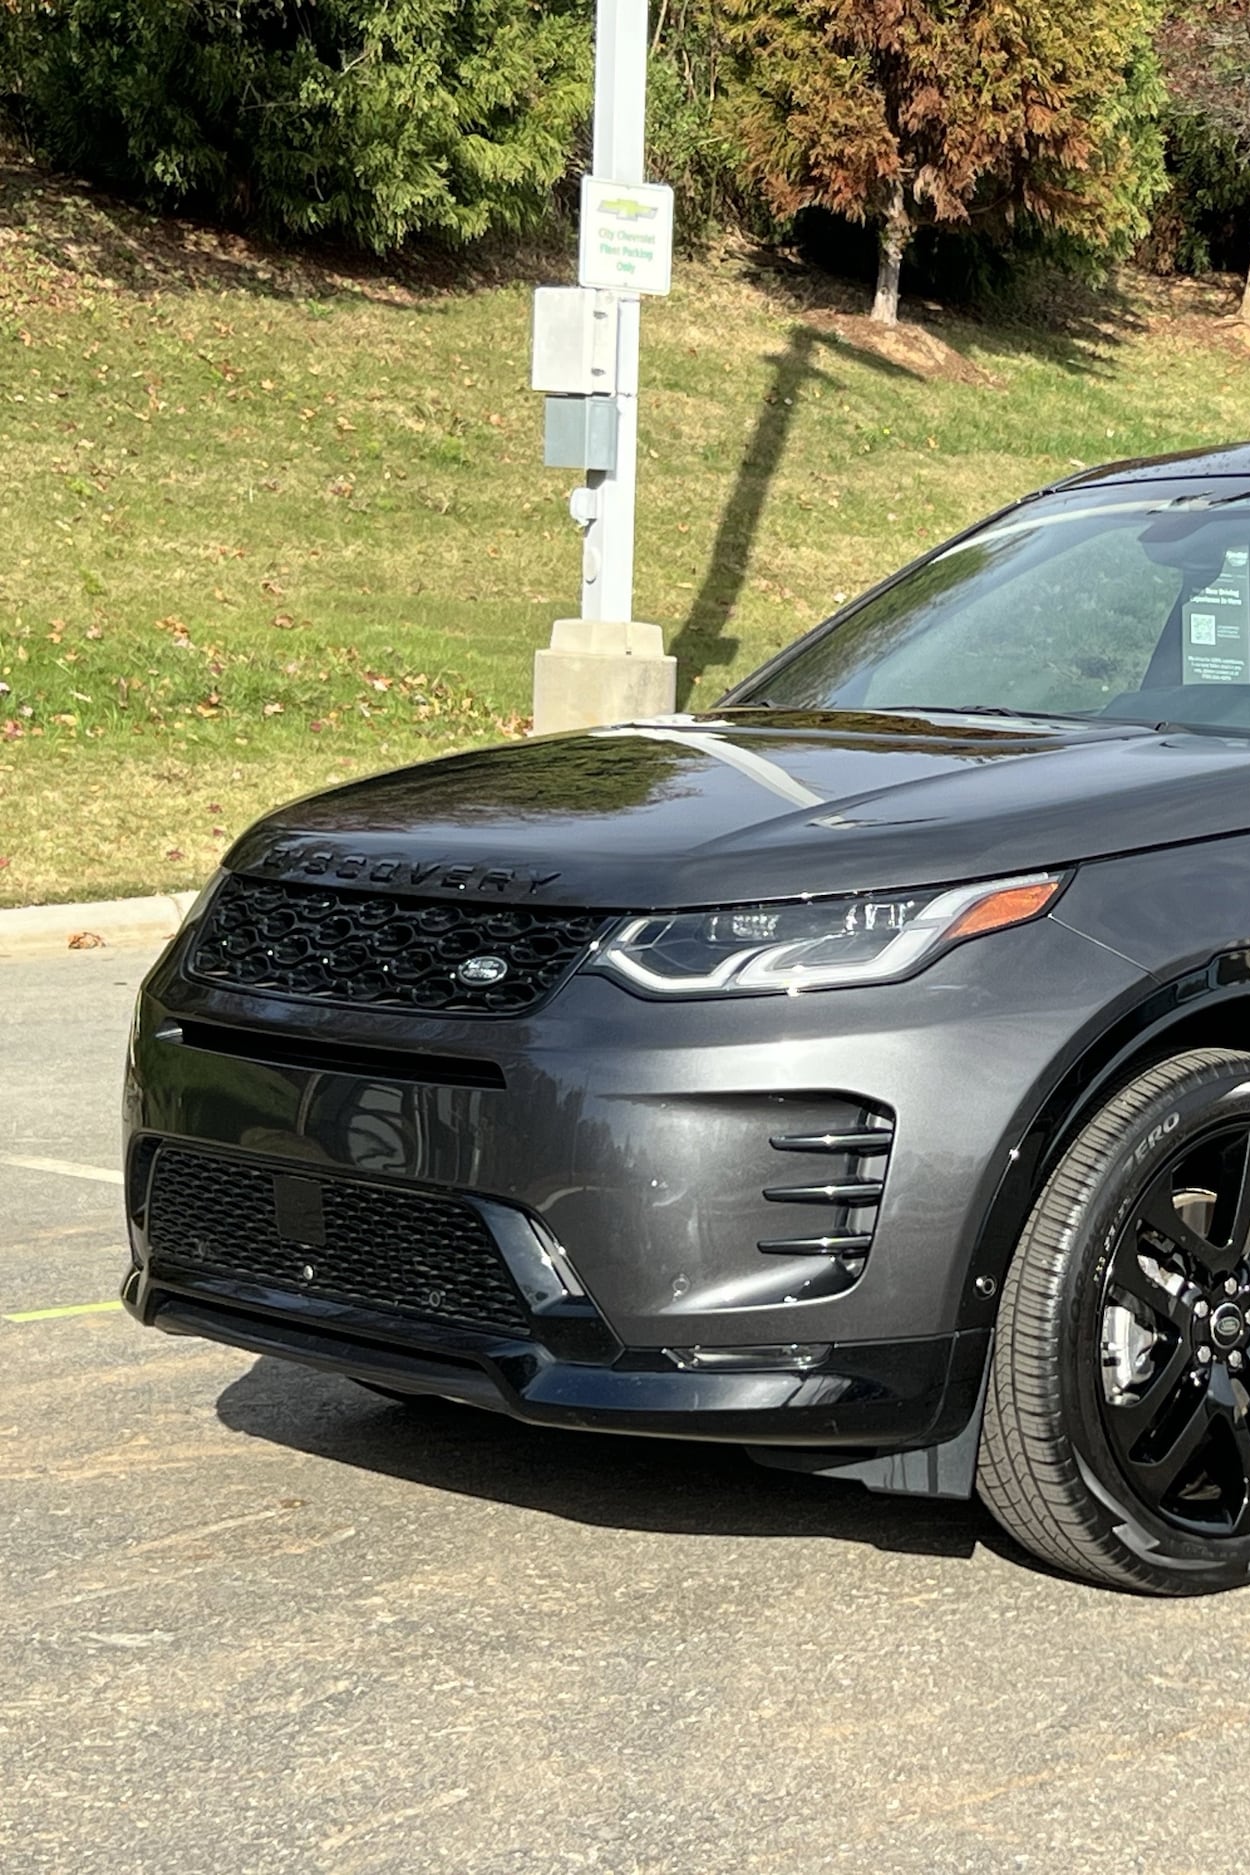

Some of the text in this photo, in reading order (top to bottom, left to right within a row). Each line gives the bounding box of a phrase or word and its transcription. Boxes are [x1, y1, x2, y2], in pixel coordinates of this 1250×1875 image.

[598, 227, 656, 245] City Chevrolet
[622, 246, 653, 262] Parking
[616, 261, 636, 275] Only
[262, 845, 564, 895] DISCOVERY
